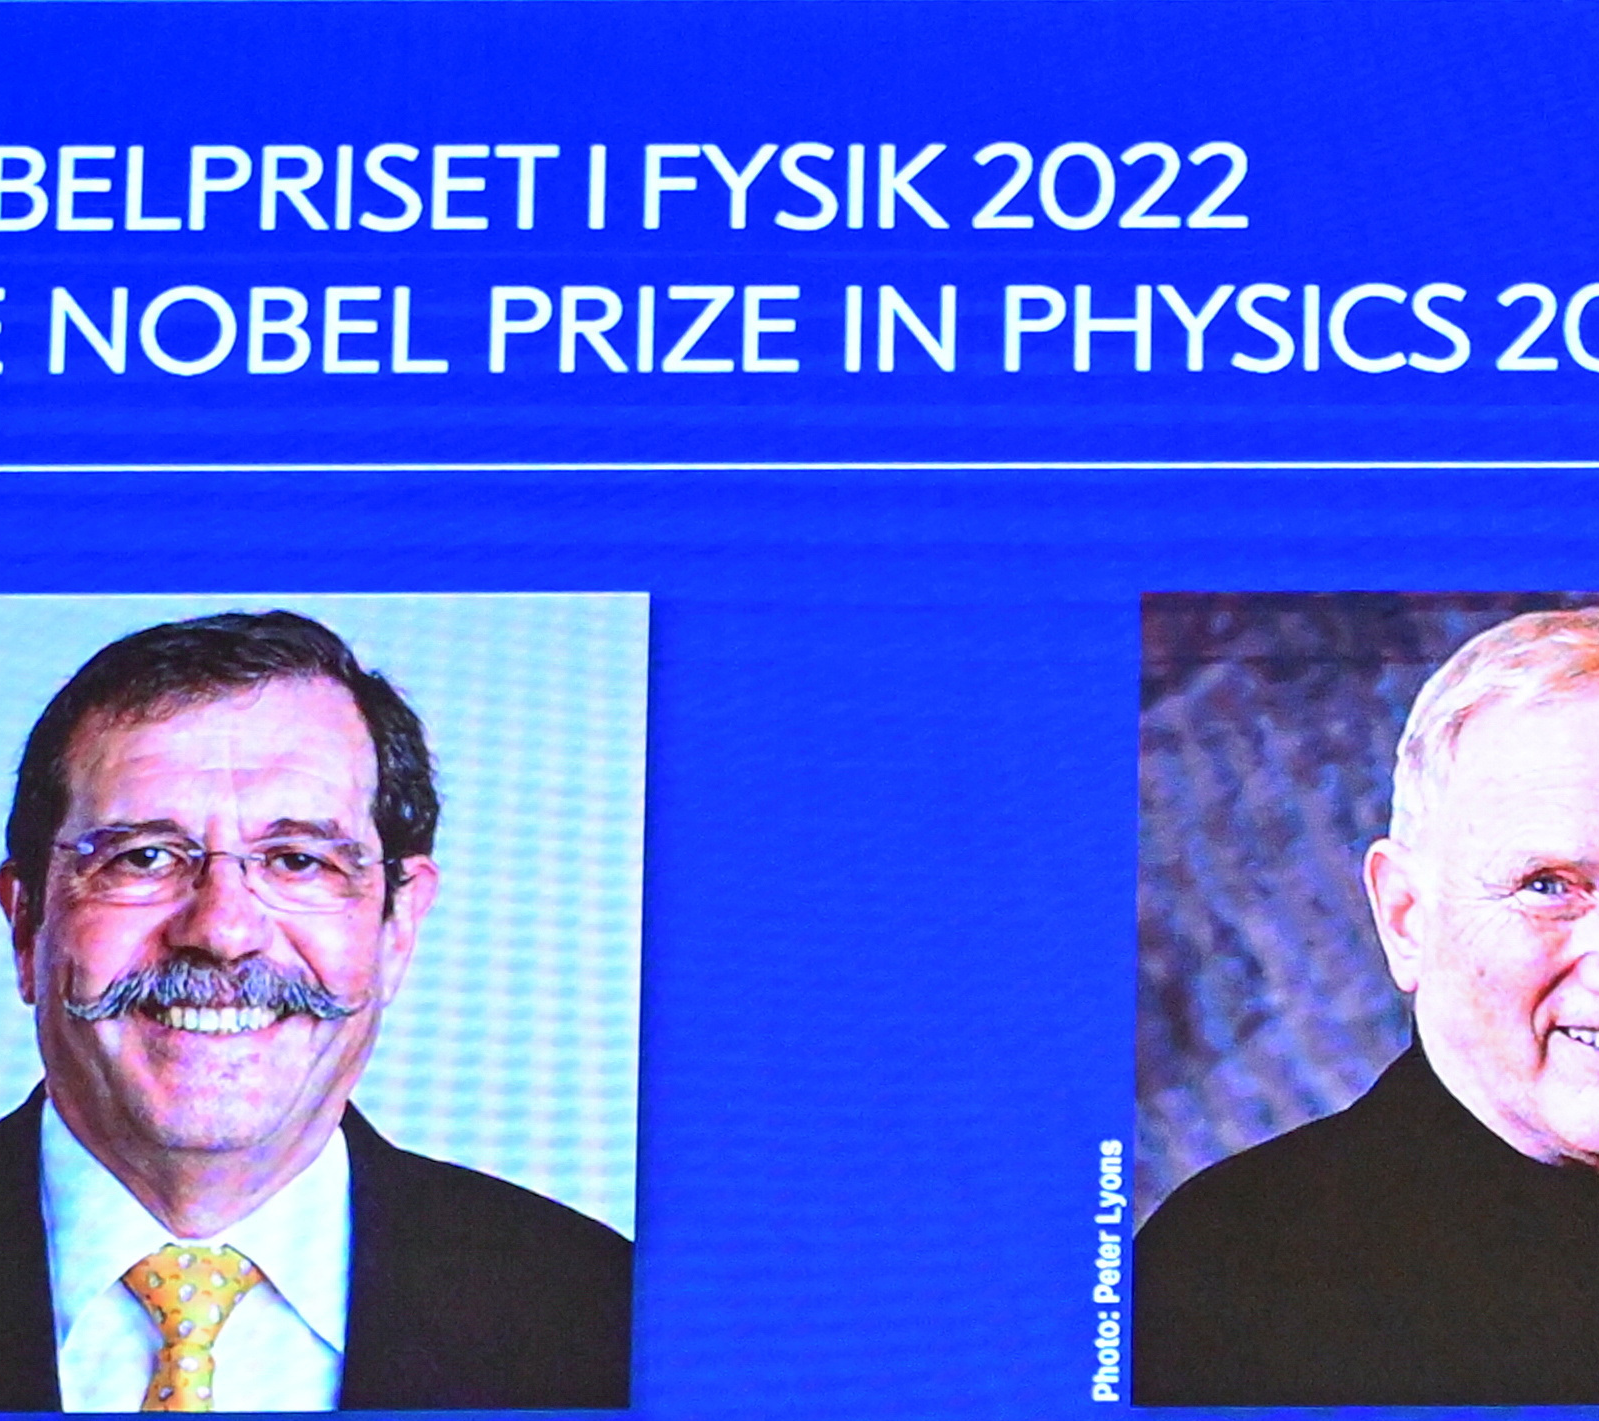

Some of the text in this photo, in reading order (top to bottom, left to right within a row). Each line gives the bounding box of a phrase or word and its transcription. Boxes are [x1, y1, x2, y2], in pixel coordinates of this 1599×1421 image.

[590, 145, 605, 229] I
[645, 143, 948, 230] FYSIK
[973, 142, 1248, 229] 2022
[51, 286, 448, 375] NOBEL
[490, 286, 799, 372] PRIZE
[846, 285, 955, 372] IN
[1005, 283, 1469, 372] PHYSICS
[1093, 1140, 1126, 1401] Photo: Peter Lyons
